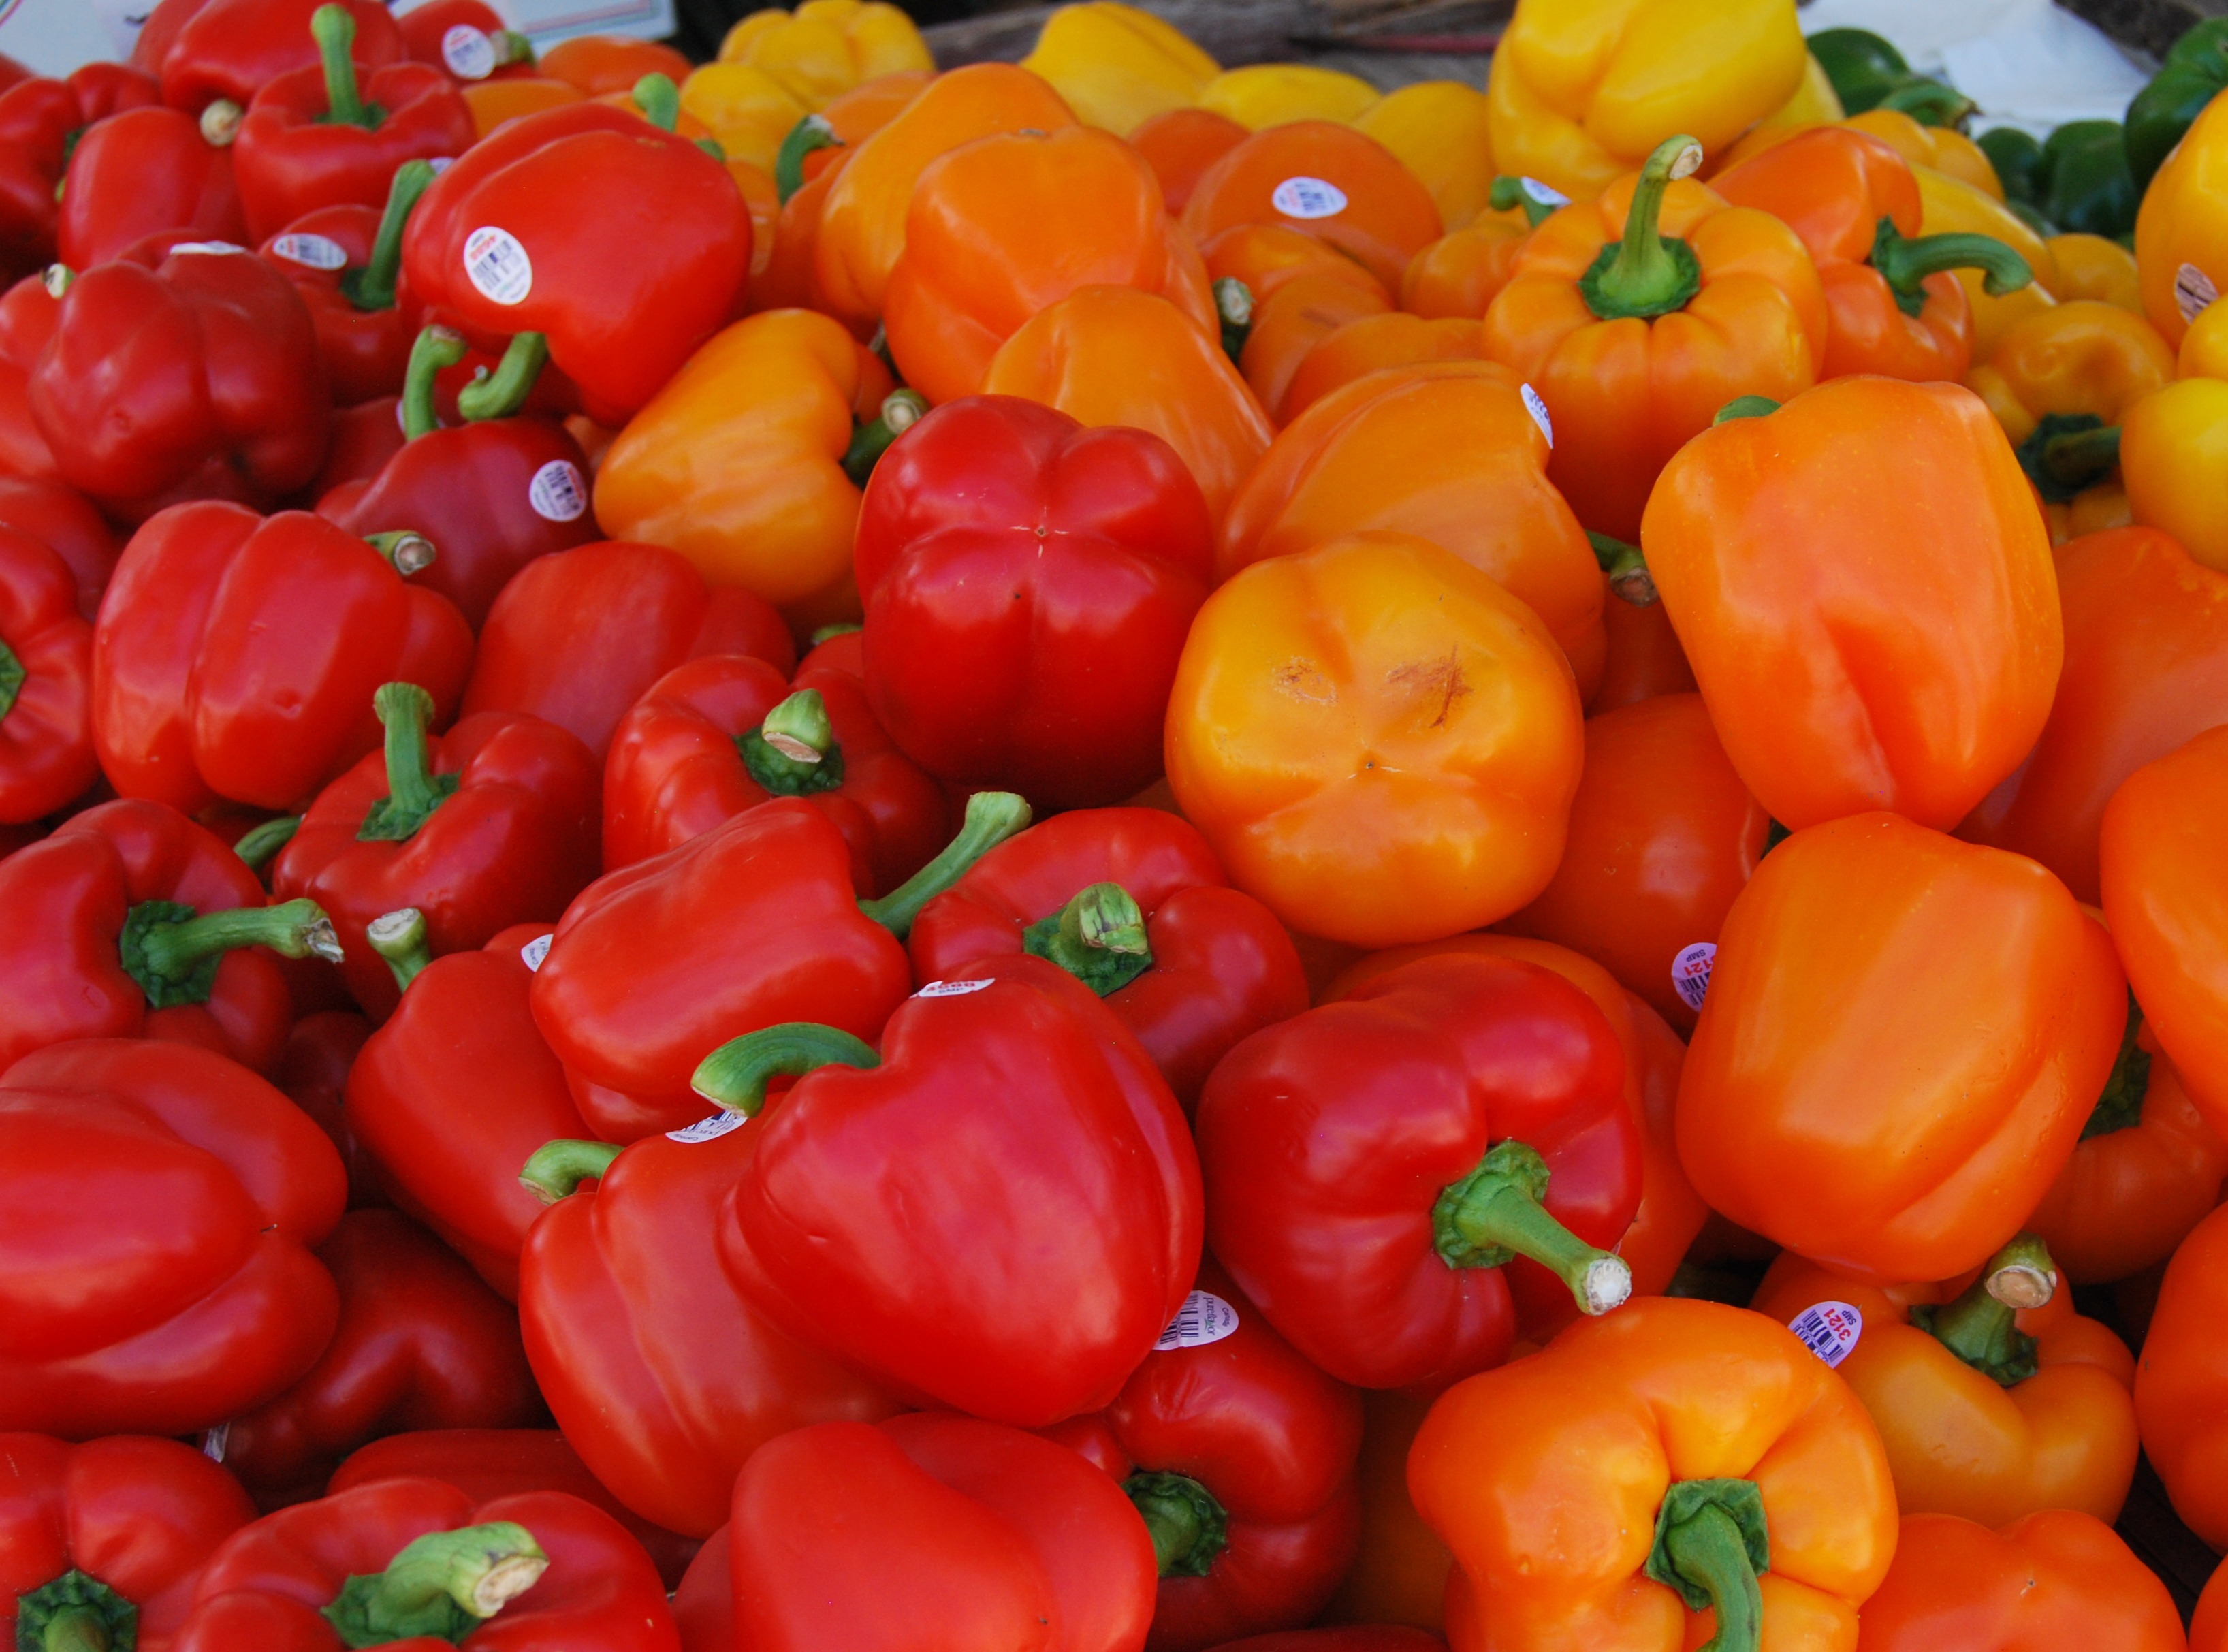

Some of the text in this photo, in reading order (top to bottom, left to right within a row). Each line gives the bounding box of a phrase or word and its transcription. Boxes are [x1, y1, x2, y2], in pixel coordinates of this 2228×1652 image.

[1686, 949, 1706, 962] SMP
[1203, 1297, 1218, 1335] pureflavor
[1824, 1308, 1851, 1341] 3121
[1841, 1310, 1858, 1326] SMP
